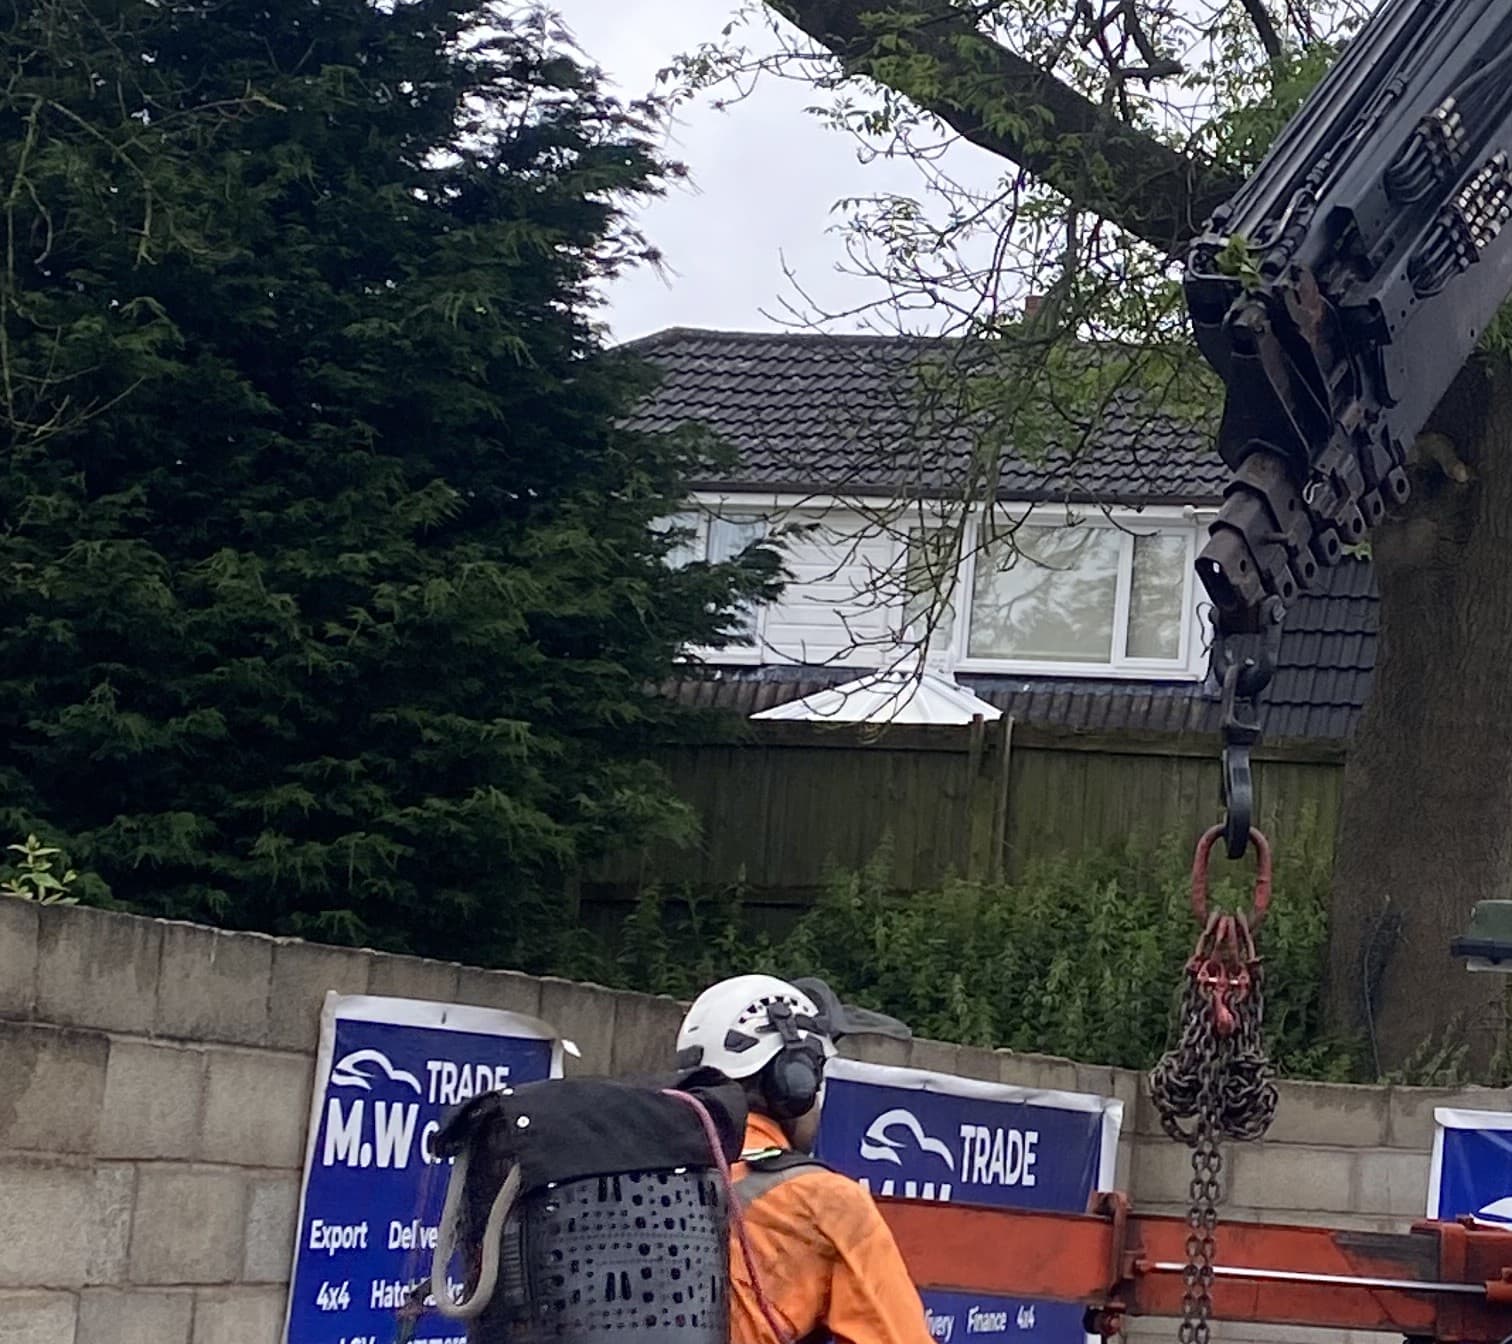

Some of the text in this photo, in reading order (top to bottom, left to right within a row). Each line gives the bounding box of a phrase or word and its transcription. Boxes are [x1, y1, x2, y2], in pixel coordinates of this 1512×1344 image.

[427, 1060, 510, 1105] TRADE
[323, 1098, 420, 1169] M.W
[960, 1124, 1039, 1186] TRADE
[309, 1219, 438, 1256] Export Delve
[316, 1280, 351, 1311] 4x4
[967, 1305, 1007, 1333] Finance
